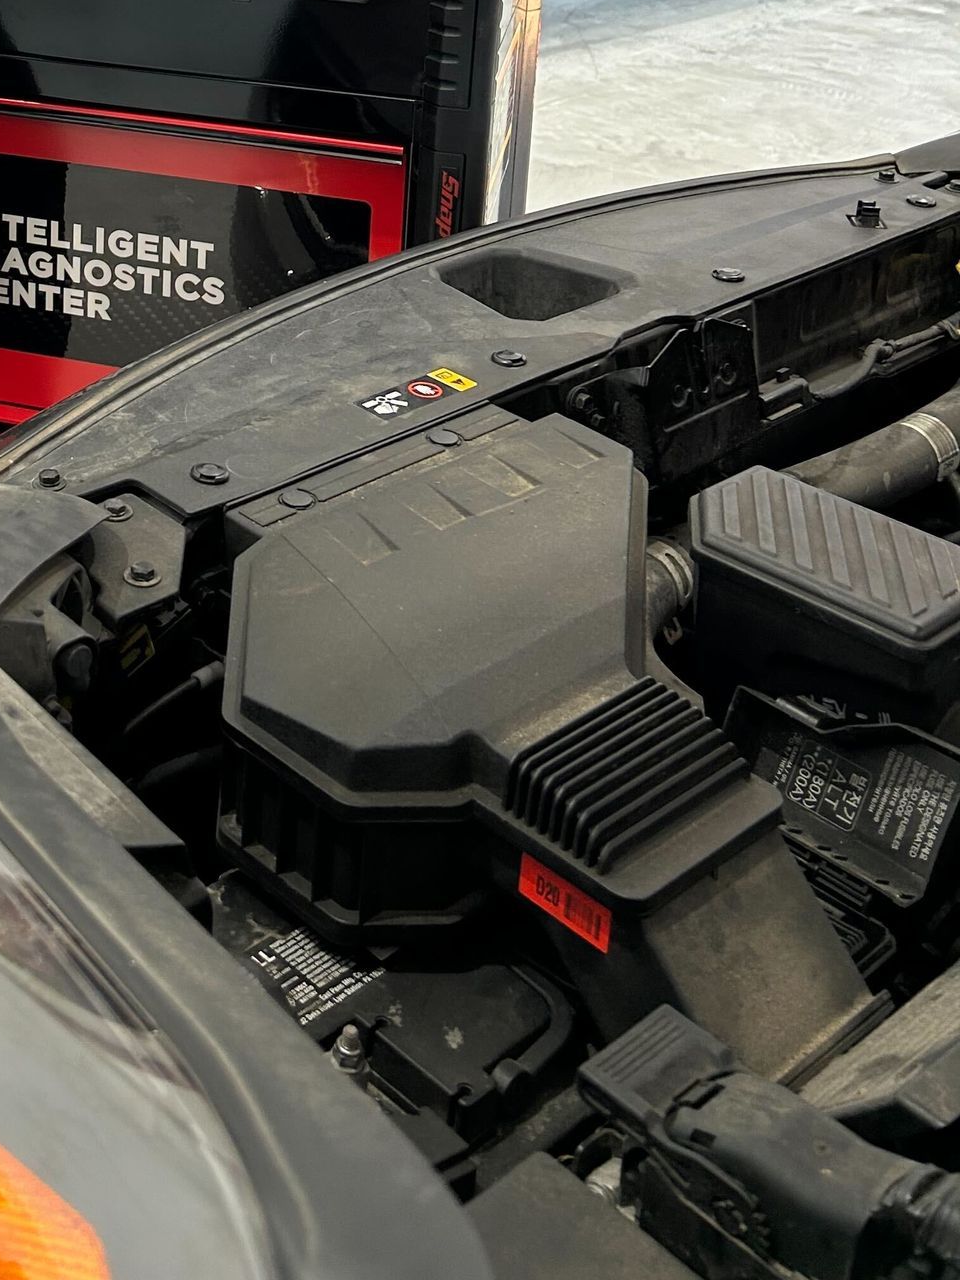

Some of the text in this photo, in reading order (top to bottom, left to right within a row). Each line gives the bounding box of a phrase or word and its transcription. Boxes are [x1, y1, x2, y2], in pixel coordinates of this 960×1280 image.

[824, 769, 847, 811] ALT
[835, 772, 868, 824] 발전기
[915, 788, 930, 814] ONLY
[927, 790, 940, 807] THE
[907, 806, 934, 858] DESIGNATED
